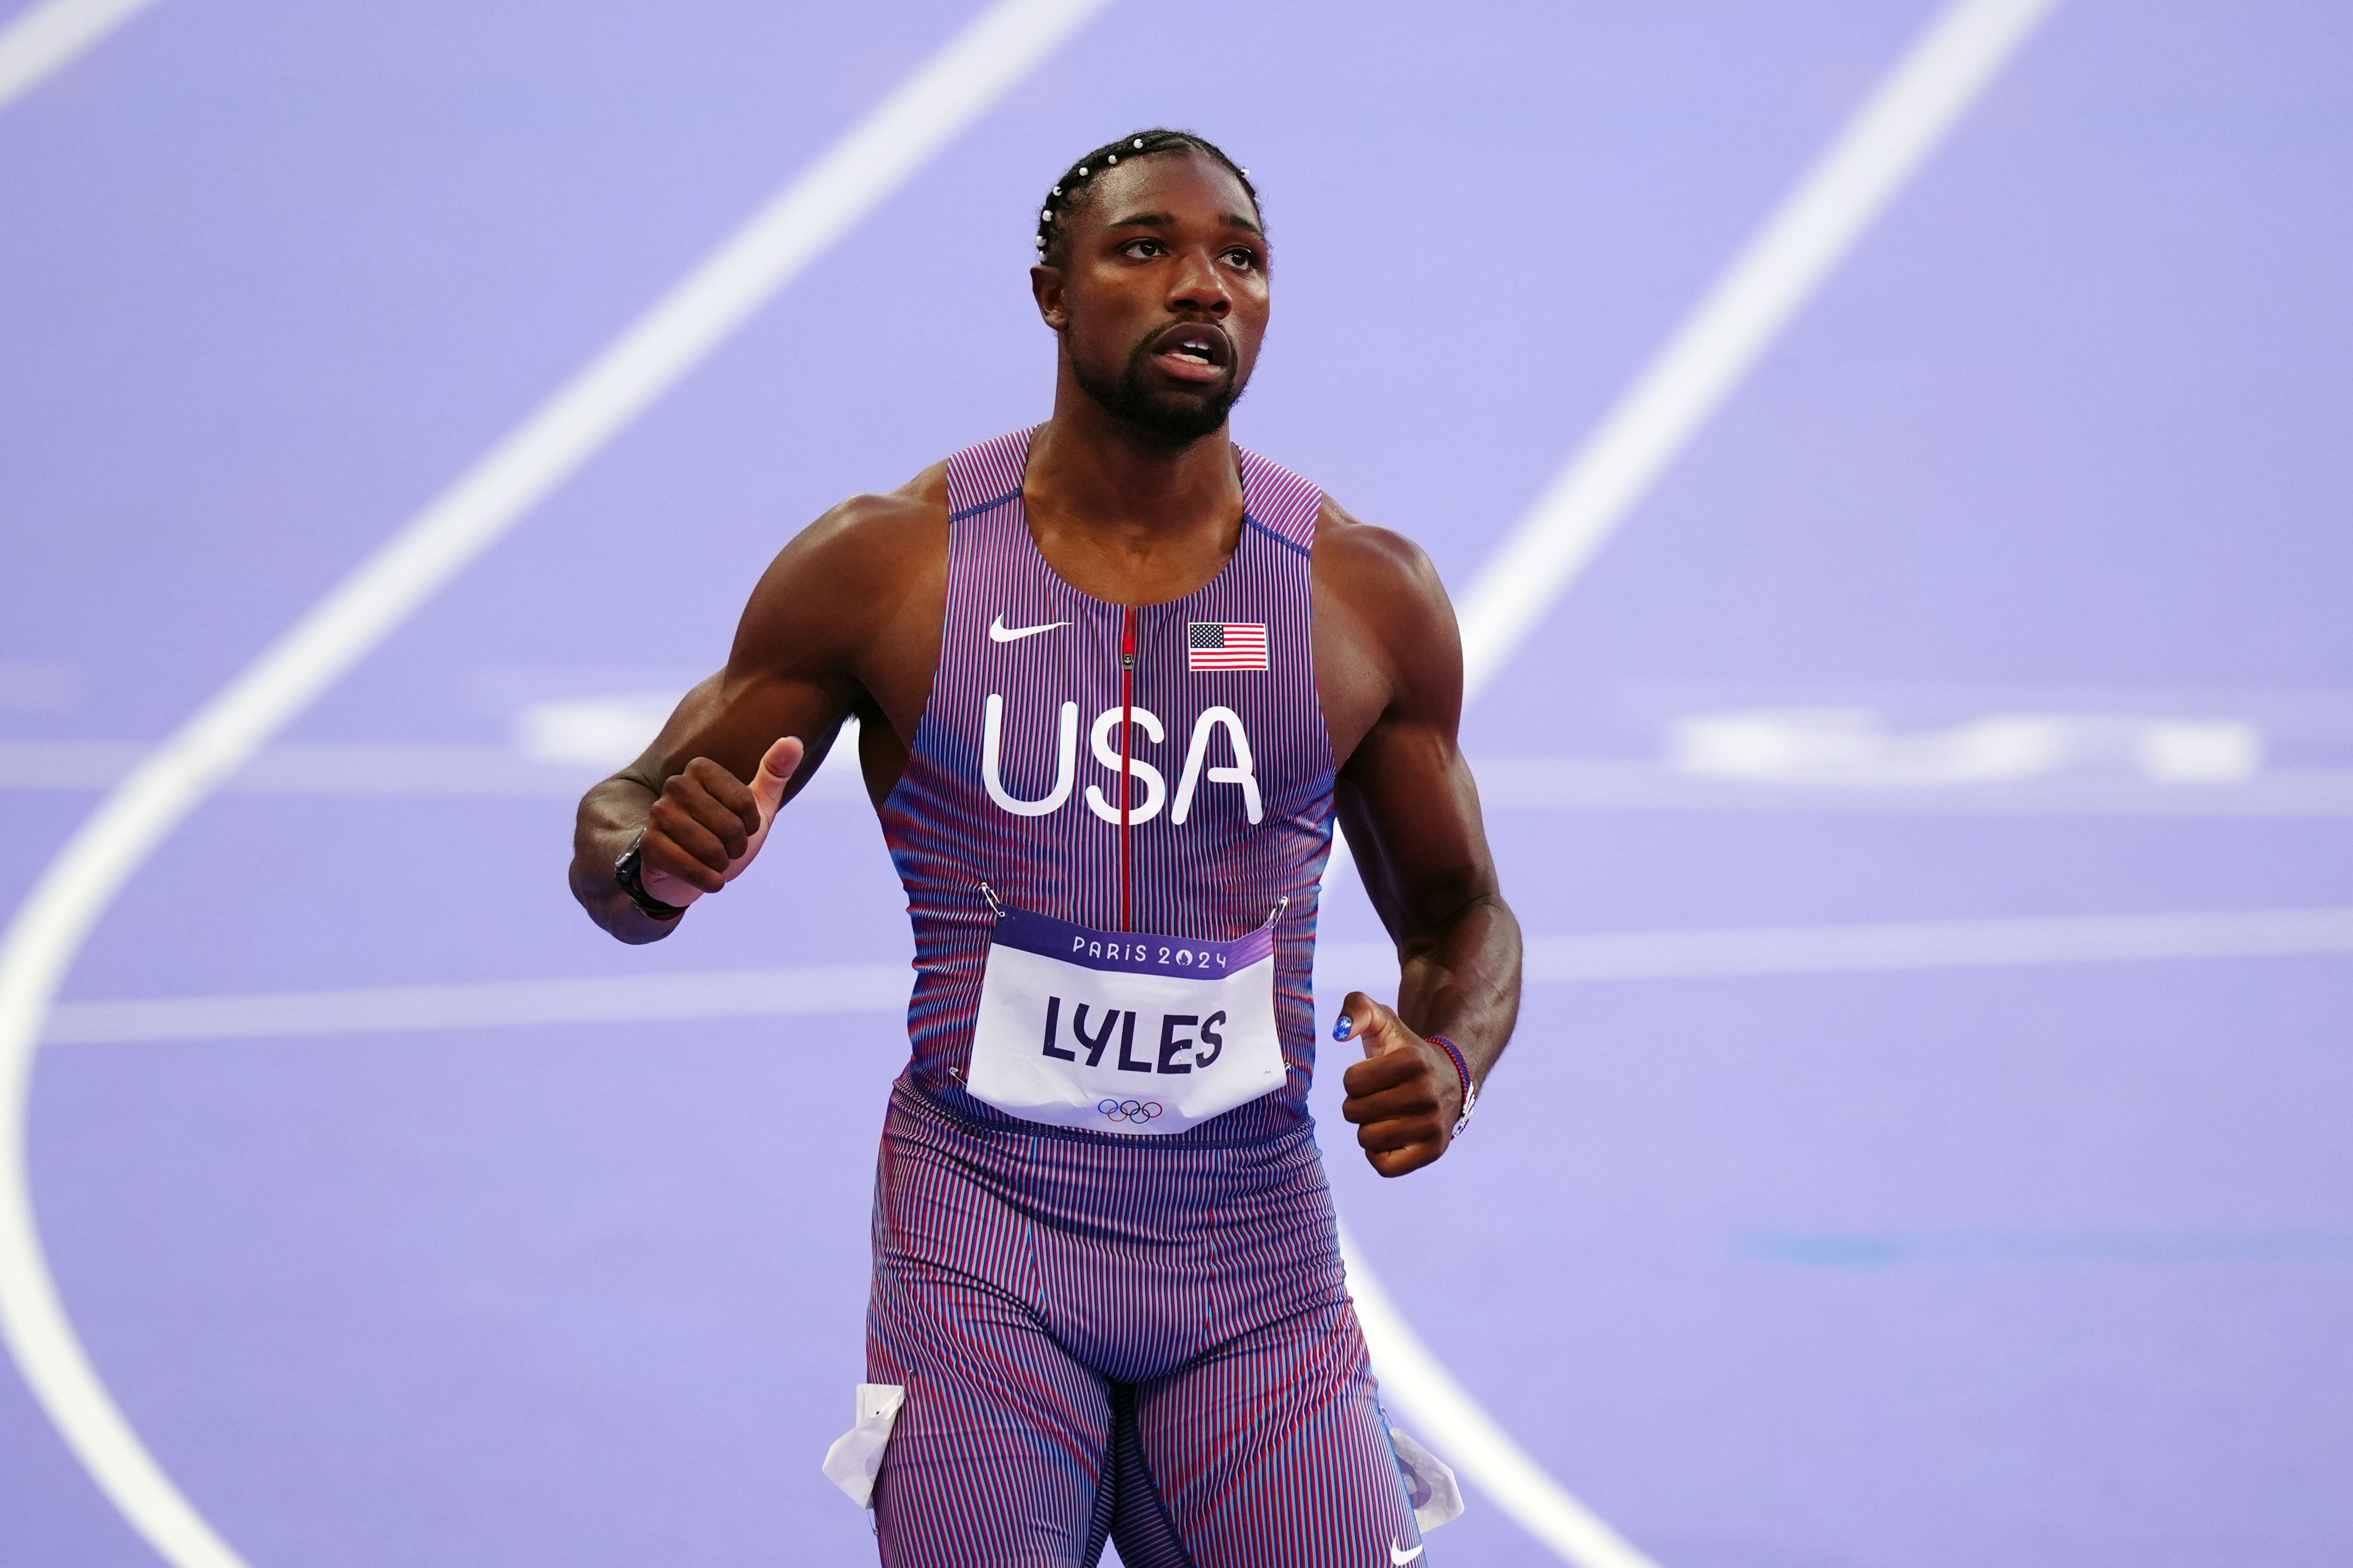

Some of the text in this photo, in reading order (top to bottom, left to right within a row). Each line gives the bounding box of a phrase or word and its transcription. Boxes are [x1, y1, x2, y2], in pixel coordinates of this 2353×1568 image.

[982, 694, 1263, 826] USA
[1158, 947, 1226, 968] 2024
[1043, 996, 1226, 1074] LYLES
